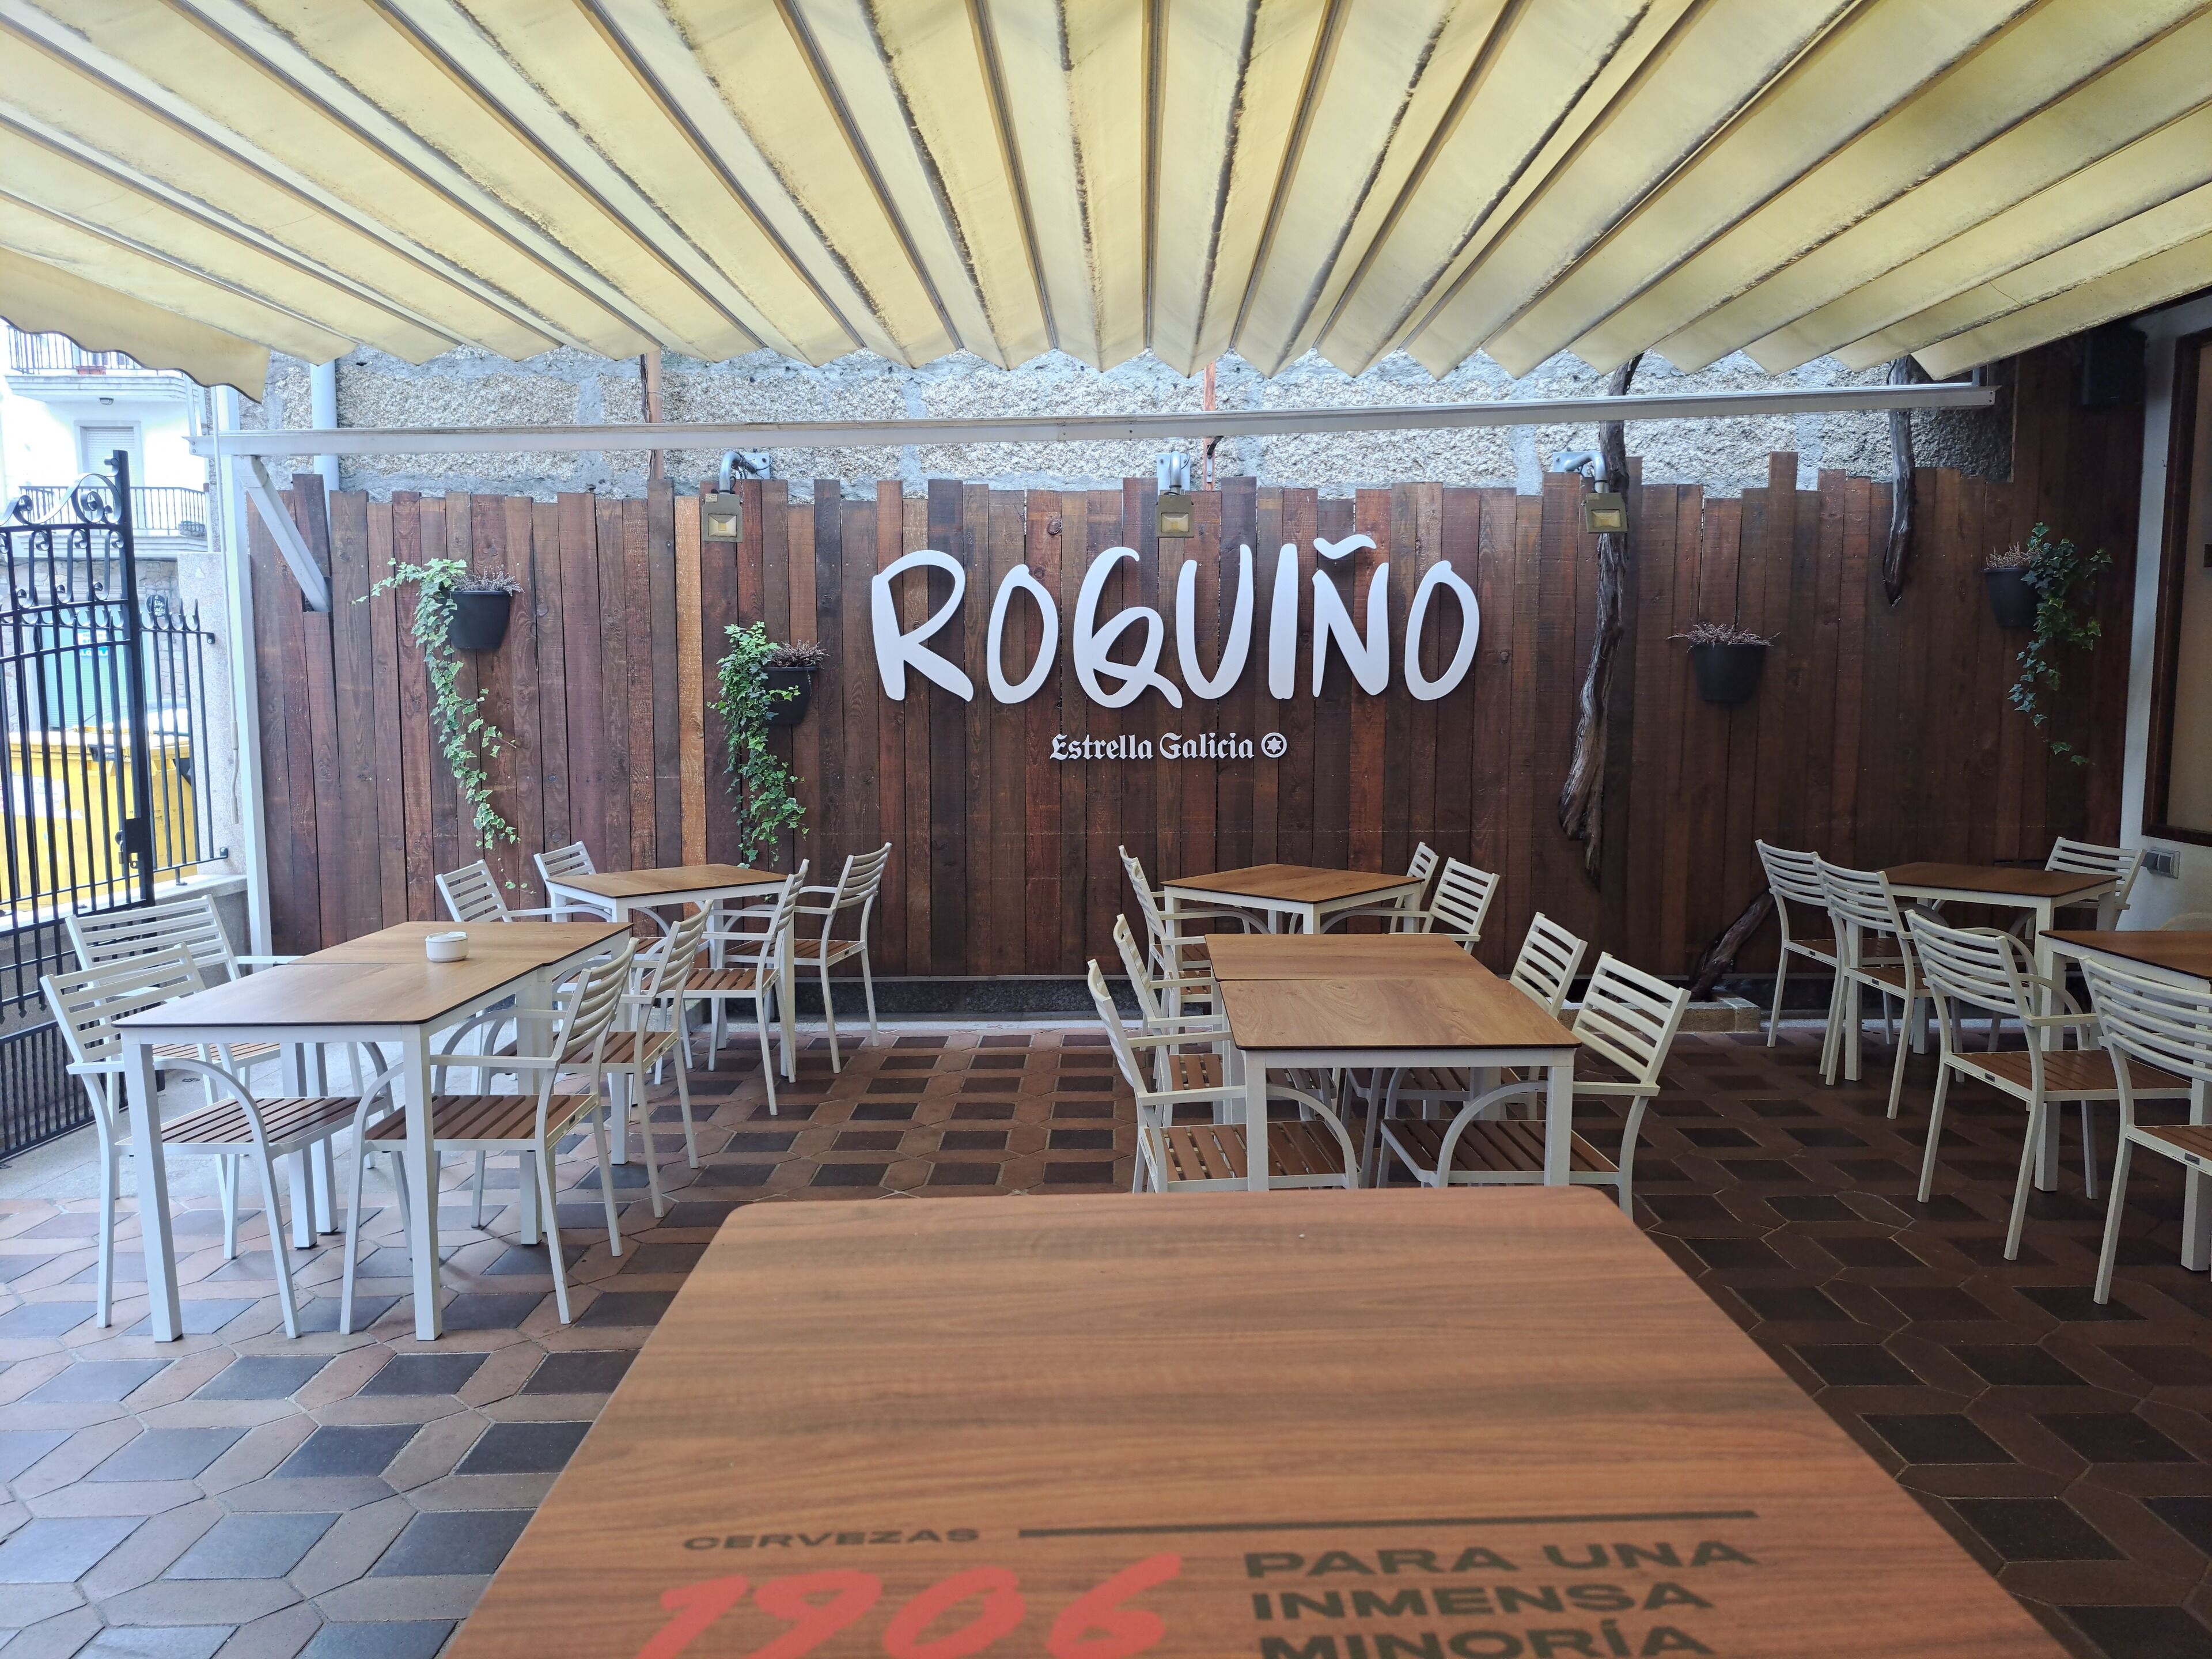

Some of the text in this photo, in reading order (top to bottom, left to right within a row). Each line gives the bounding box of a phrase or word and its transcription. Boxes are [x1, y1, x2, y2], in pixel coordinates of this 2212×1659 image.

[871, 533, 1480, 709] ROQUIÑO
[1049, 732, 1255, 760] Estrella Galicia
[683, 1528, 979, 1551] CERVEZAS
[1244, 1540, 1760, 1578] PARA UNA
[634, 1552, 1181, 1659] 1906
[1251, 1581, 1715, 1621] INMENSA
[1259, 1618, 1718, 1659] MINORÍA
